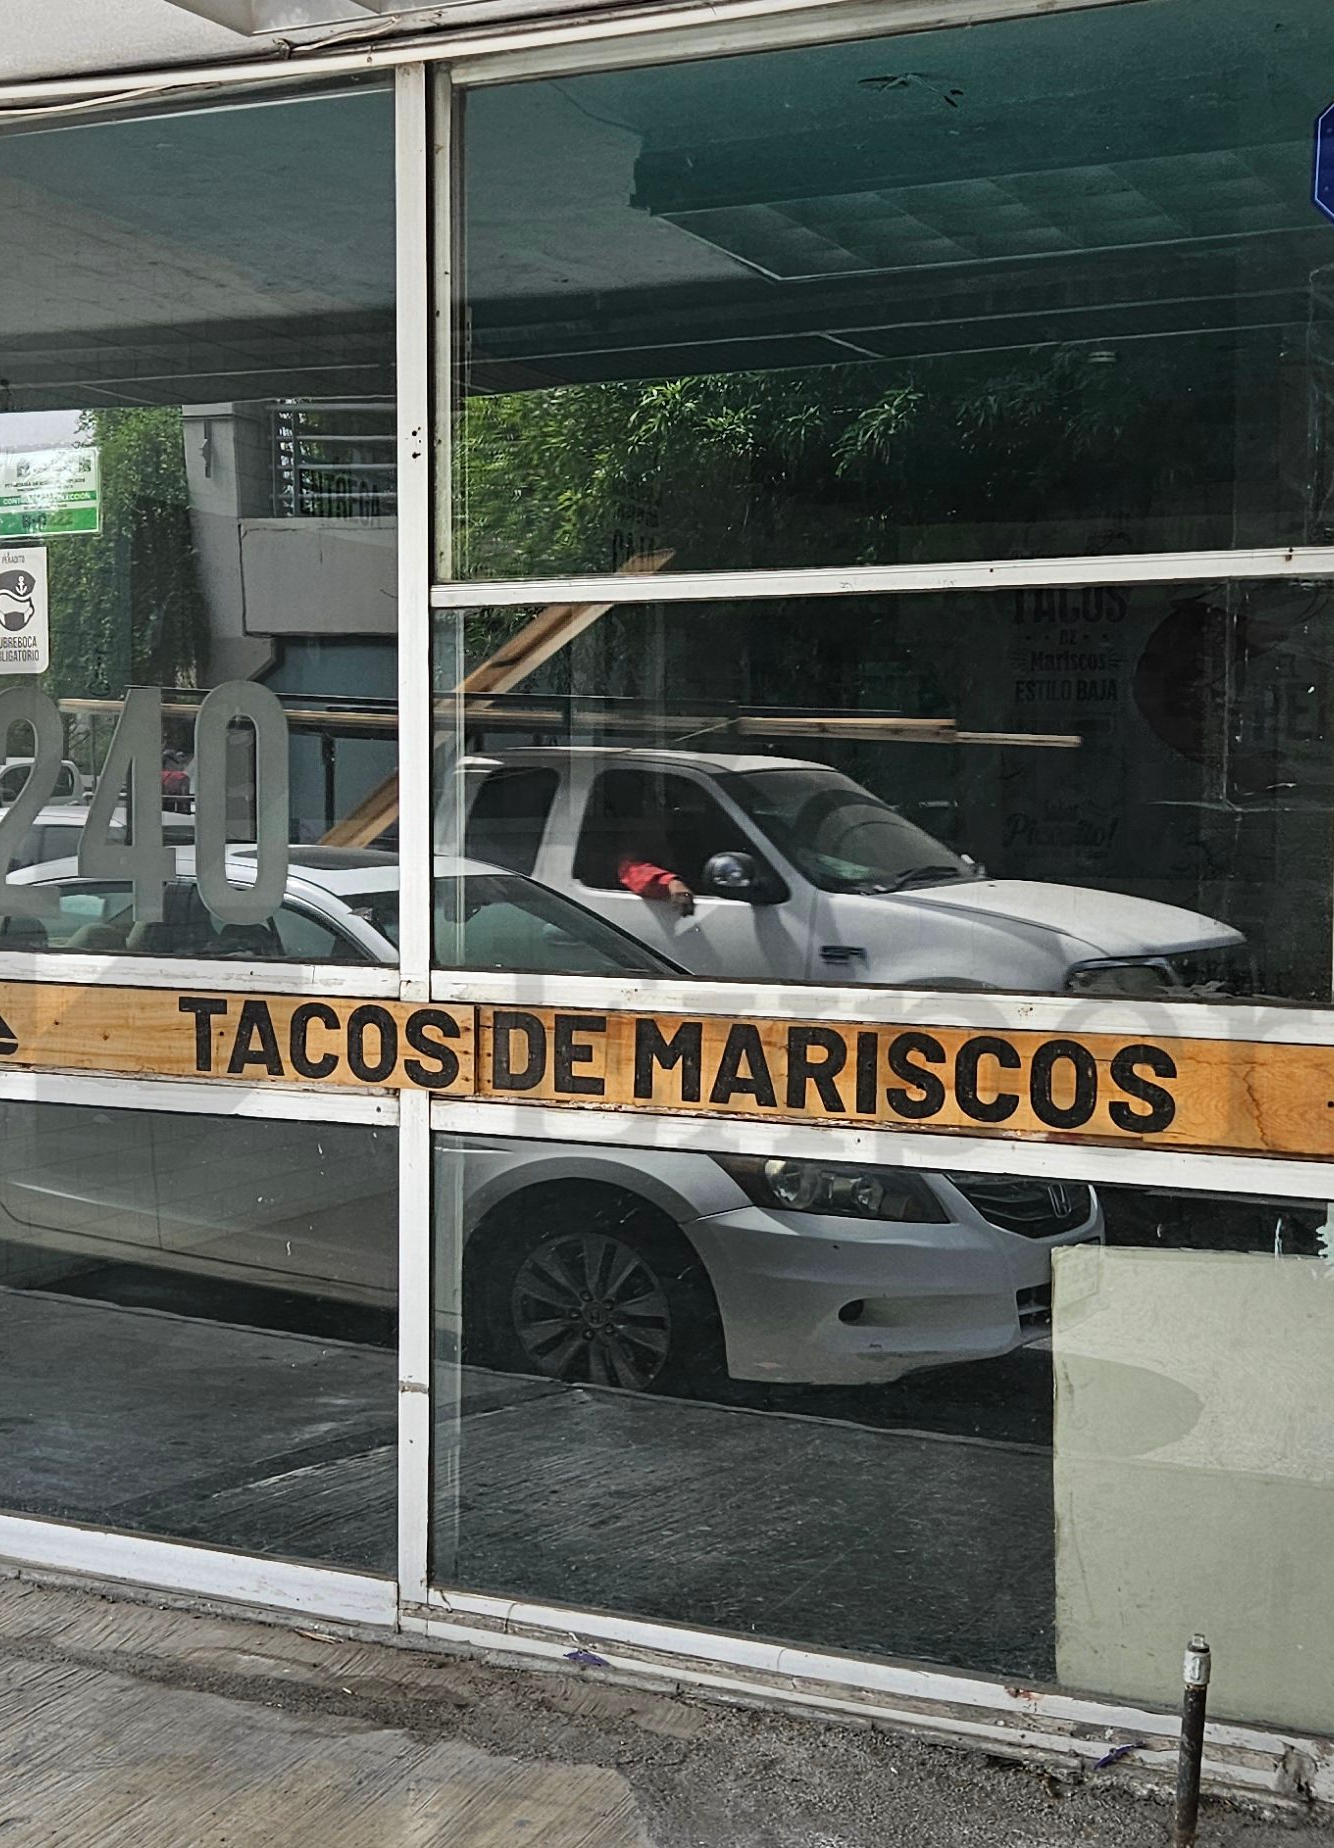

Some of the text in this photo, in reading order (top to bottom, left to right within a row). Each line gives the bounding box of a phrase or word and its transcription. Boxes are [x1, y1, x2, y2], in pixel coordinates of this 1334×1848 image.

[1012, 588, 1129, 625] TACOS
[1059, 632, 1078, 646] DE
[1030, 650, 1108, 673] Mariscos
[1015, 679, 1119, 702] ESTILO BAJA
[178, 996, 1178, 1135] TACOS DE MARISCOS
